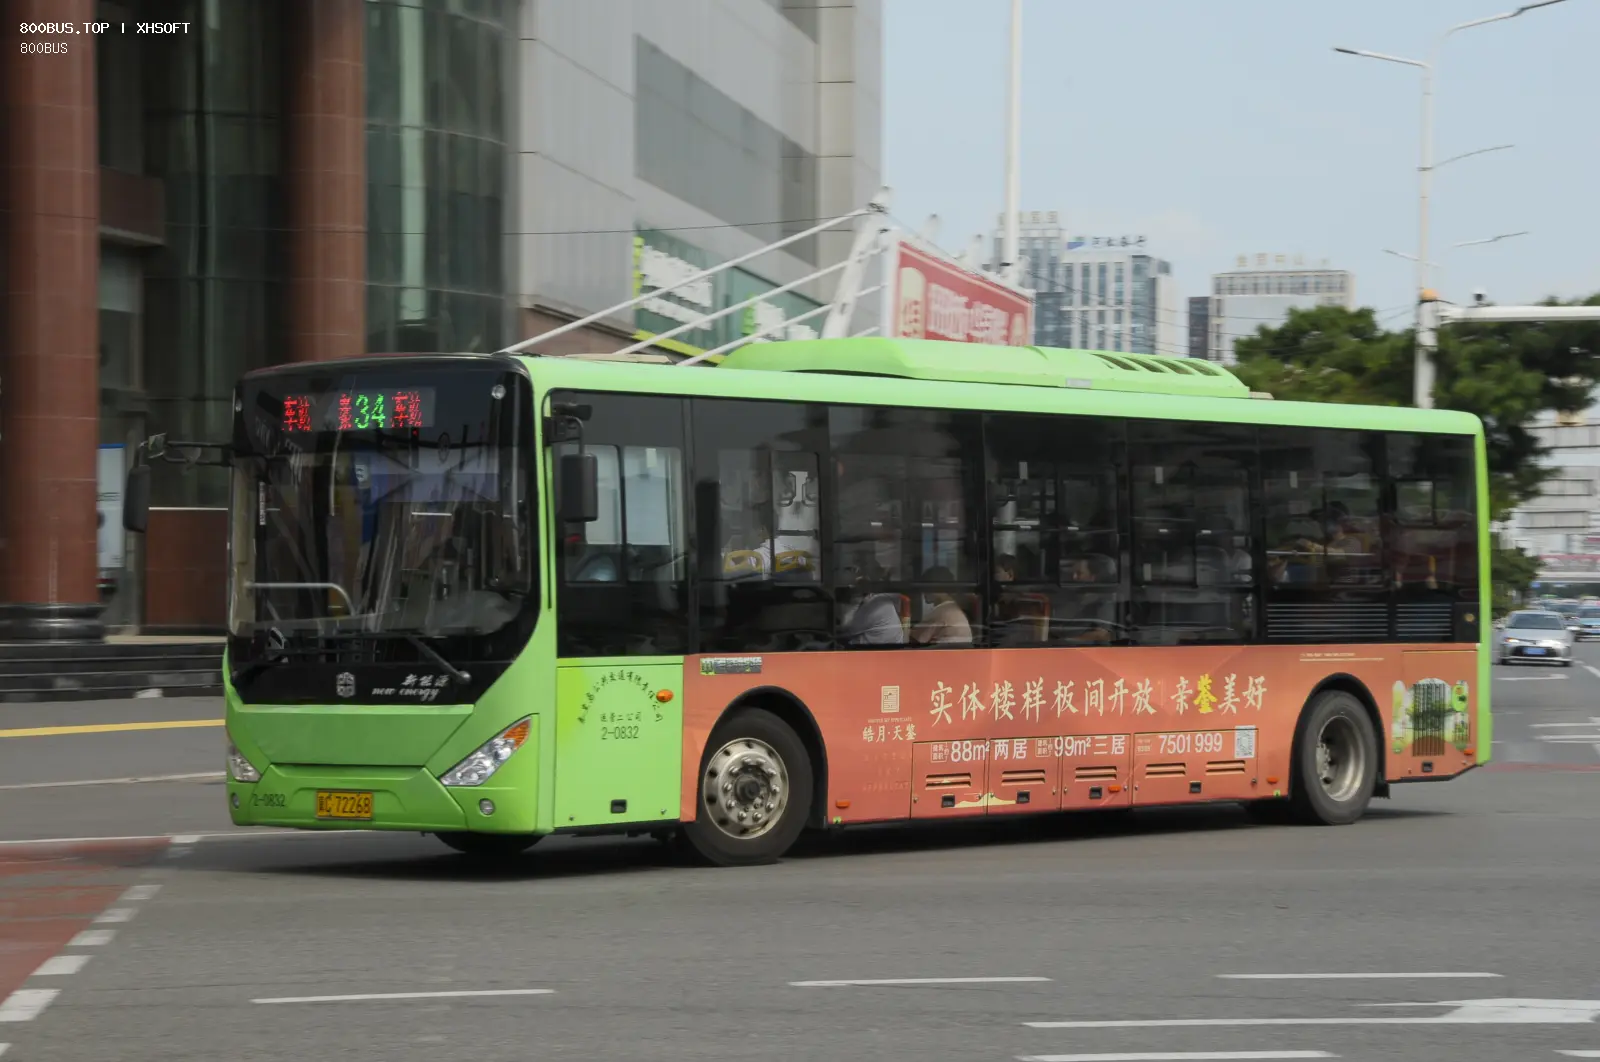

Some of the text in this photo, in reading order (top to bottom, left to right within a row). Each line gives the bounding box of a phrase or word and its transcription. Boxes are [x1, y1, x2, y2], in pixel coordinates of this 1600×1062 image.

[354, 393, 386, 429] 34
[401, 673, 450, 687] 新能源
[371, 687, 441, 702] new energy
[929, 673, 1267, 727] 实体楼样板间开放 亲鉴美好
[601, 725, 639, 740] 2-0832
[253, 793, 286, 807] 2-0832
